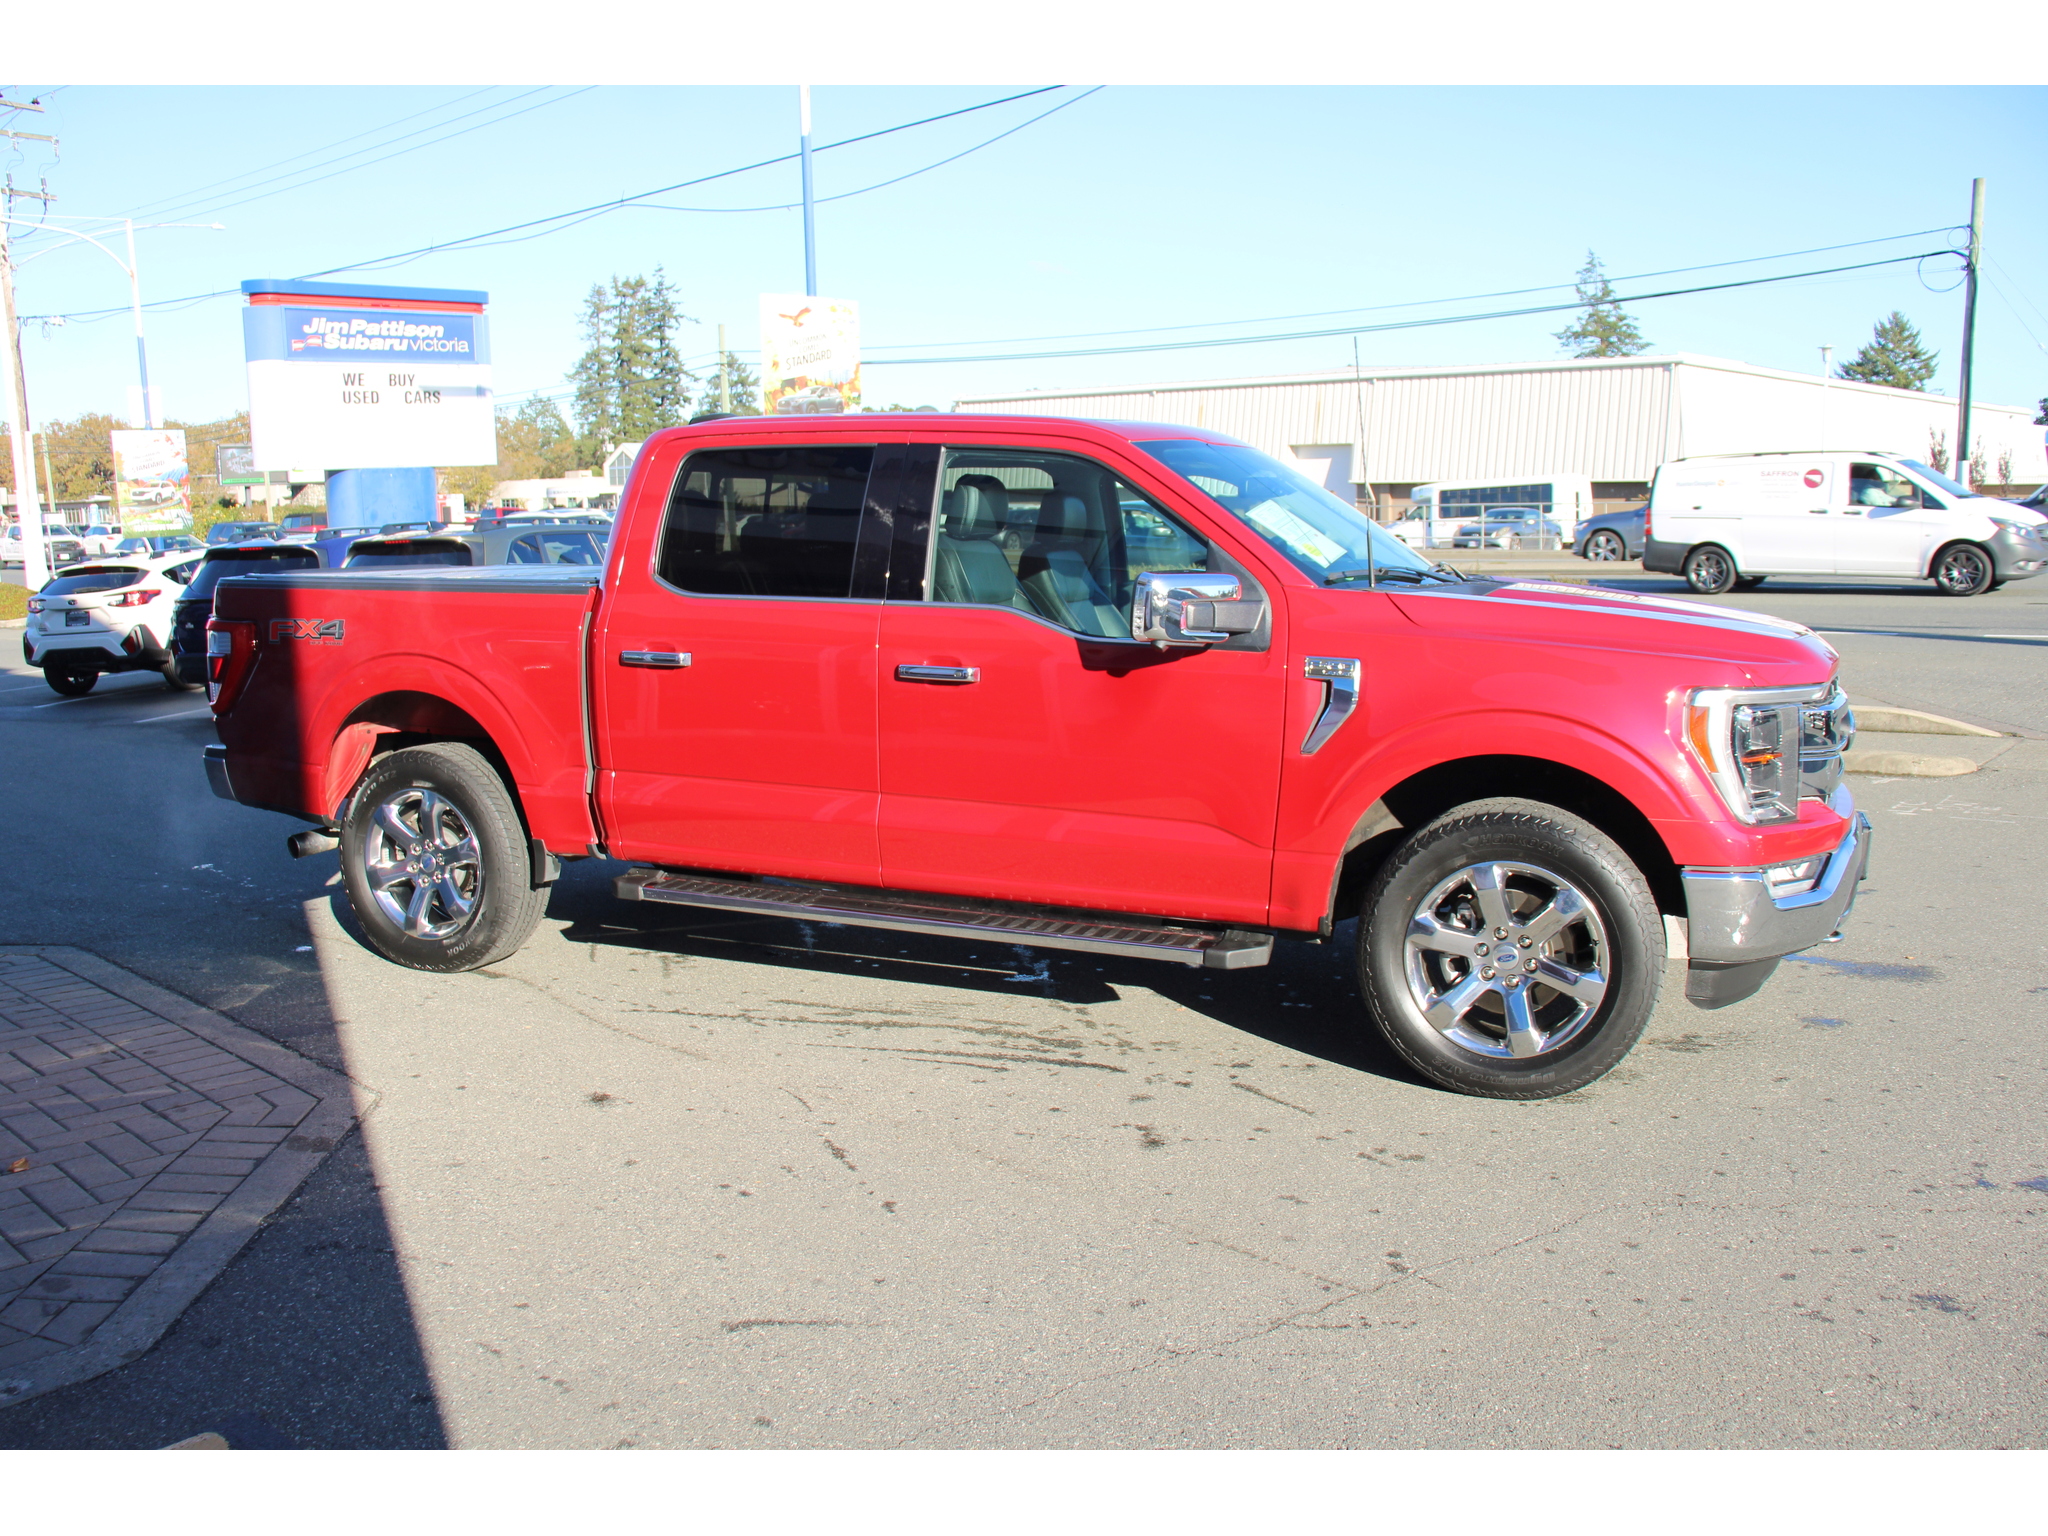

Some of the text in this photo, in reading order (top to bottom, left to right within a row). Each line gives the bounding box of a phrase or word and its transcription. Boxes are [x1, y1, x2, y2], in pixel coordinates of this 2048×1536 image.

[303, 318, 444, 337] Jim Pattison
[324, 335, 470, 353] Subaru victoria
[786, 349, 832, 370] STANDARD
[342, 373, 416, 387] WE BUY
[342, 390, 442, 404] USED CARS
[269, 618, 346, 644] FX4
